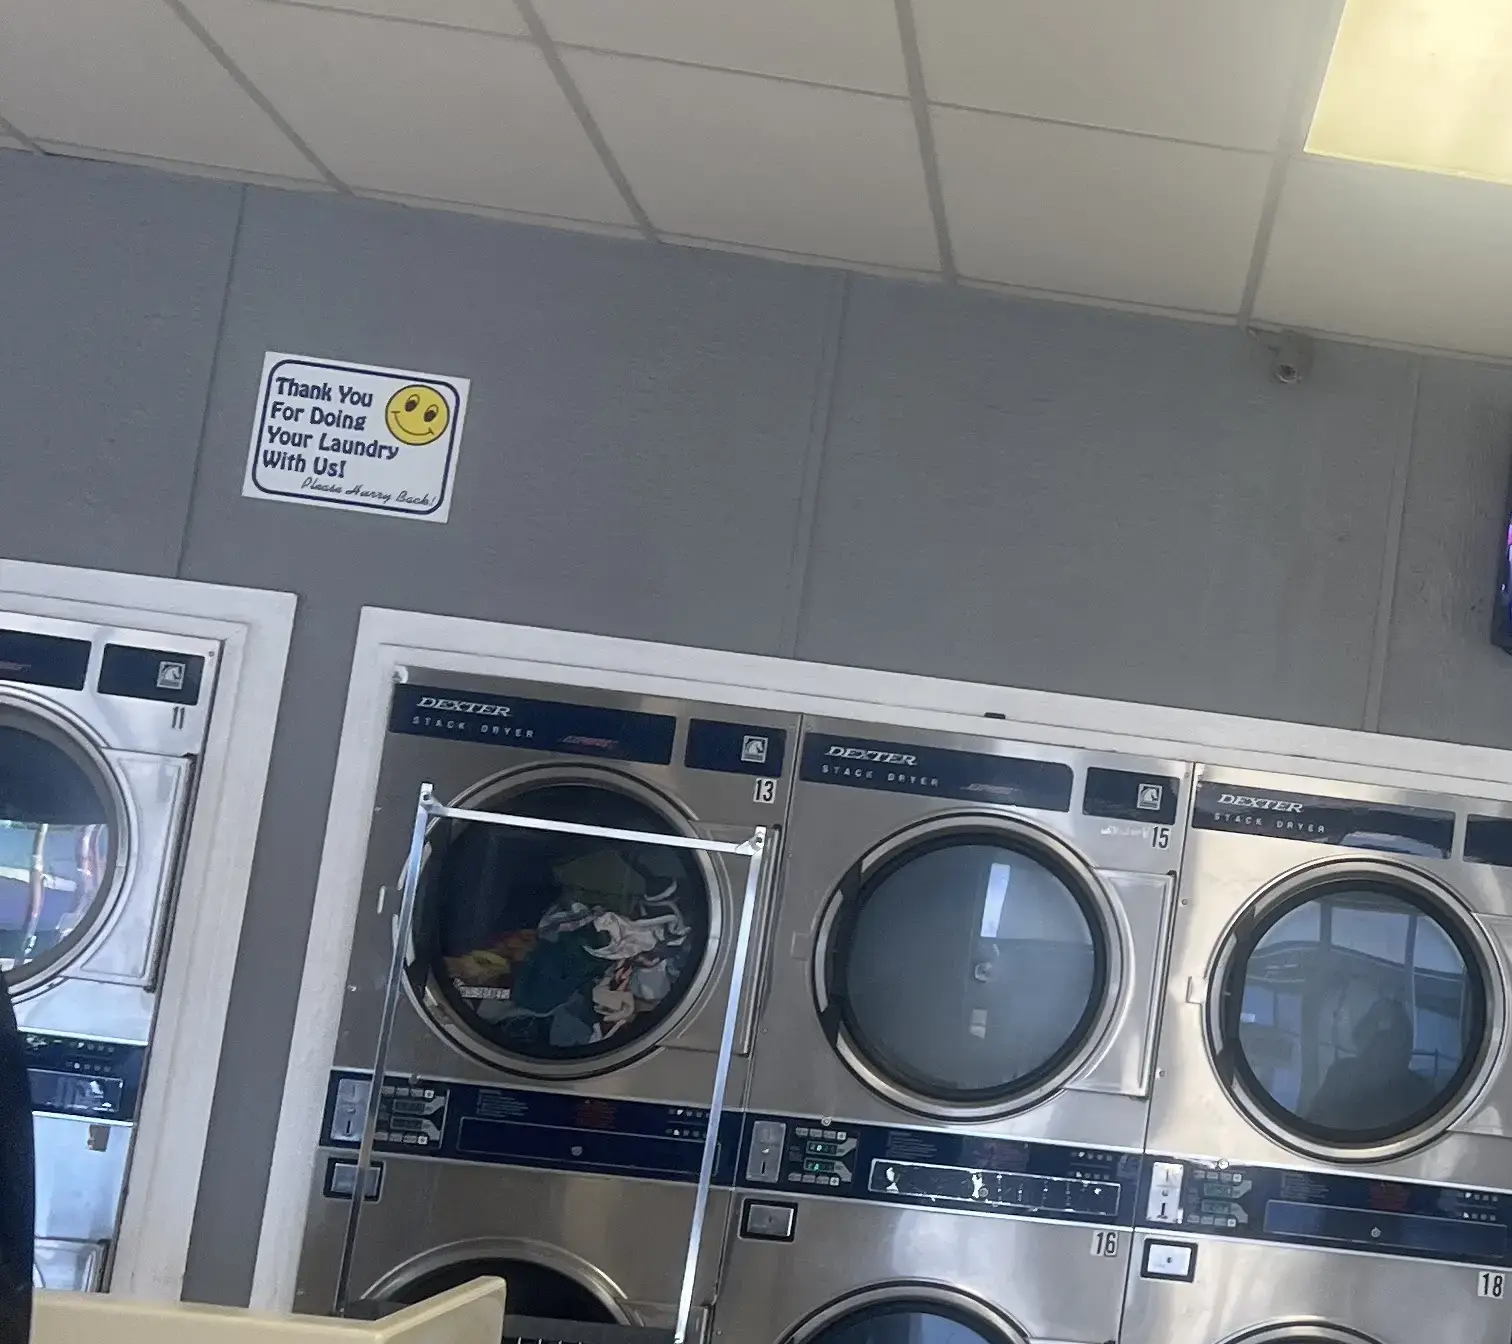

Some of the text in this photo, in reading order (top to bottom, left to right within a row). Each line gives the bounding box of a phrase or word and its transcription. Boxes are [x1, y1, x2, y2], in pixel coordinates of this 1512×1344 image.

[275, 376, 373, 408] Thank You
[270, 401, 367, 432] For Doing
[268, 425, 400, 460] Your Laundry
[262, 449, 347, 479] With Us!
[301, 476, 437, 506] Please Hurry Back!
[172, 706, 185, 730] 11
[416, 696, 512, 717] DEXTER
[412, 716, 534, 738] STACK DRYER
[825, 745, 918, 766] DEXTER
[822, 764, 939, 787] STACK DRYER
[755, 779, 775, 803] 13
[1217, 793, 1305, 814] DEXTER
[1213, 812, 1325, 833] STACK DRYER
[1151, 826, 1170, 849] 15
[1096, 1232, 1116, 1255] 16
[1483, 1273, 1503, 1297] 18
